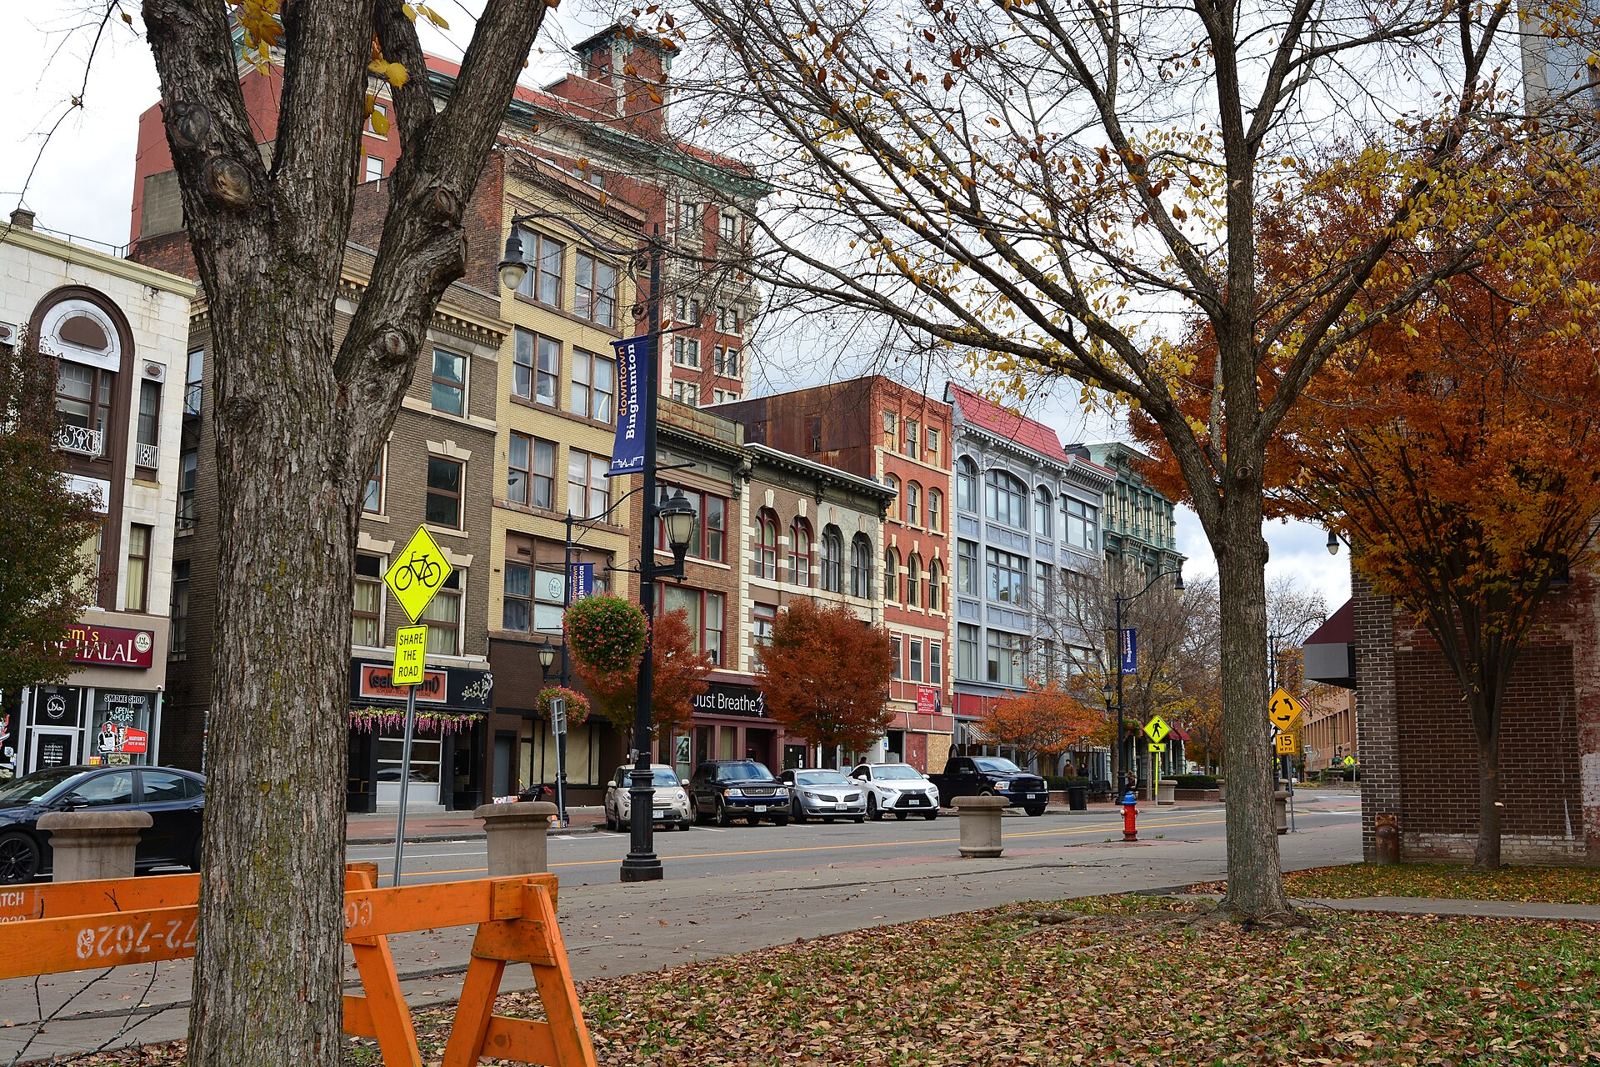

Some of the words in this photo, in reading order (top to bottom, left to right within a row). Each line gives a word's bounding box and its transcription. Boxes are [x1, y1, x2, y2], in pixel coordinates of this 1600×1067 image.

[618, 346, 628, 417] downtown
[625, 343, 639, 440] Binghamton
[399, 633, 423, 646] SHARE
[403, 650, 417, 661] THE
[398, 666, 418, 678] ROAD
[104, 693, 128, 704] SMOKE
[128, 694, 146, 704] SHOP
[693, 693, 716, 709] Just
[717, 693, 758, 712] Breathe.
[115, 706, 129, 715] OPEN
[1280, 735, 1292, 746] 15
